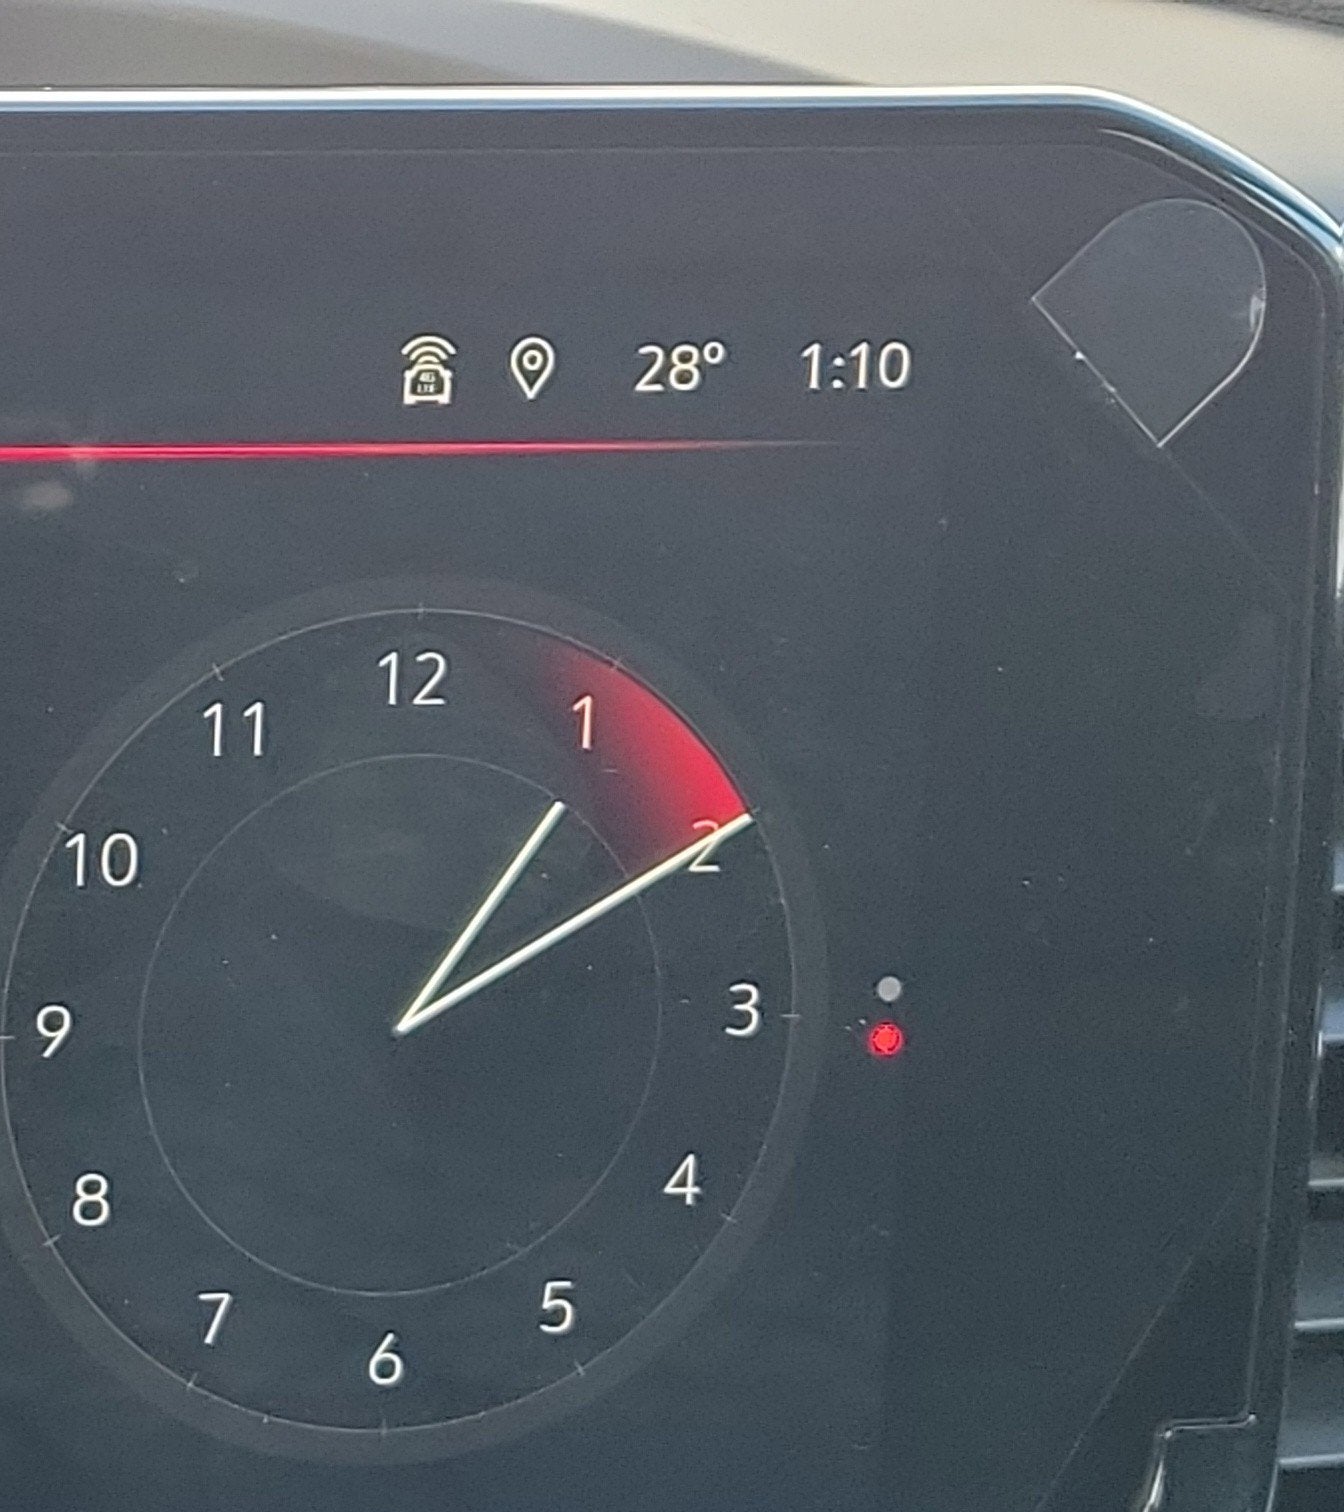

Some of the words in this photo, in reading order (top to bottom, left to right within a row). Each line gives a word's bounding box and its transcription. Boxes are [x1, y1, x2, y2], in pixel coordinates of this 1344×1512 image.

[634, 341, 725, 392] 28°
[801, 342, 910, 389] 1:10
[378, 651, 446, 705] 12
[203, 701, 263, 757] 11
[572, 695, 593, 749] 1
[65, 833, 138, 887] 10
[688, 819, 720, 873] 2
[36, 1005, 71, 1058] 9
[725, 983, 759, 1036] 3
[72, 1173, 110, 1227] 8
[663, 1153, 701, 1205] 4
[198, 1292, 231, 1344] 7
[539, 1280, 573, 1333] 5
[368, 1333, 403, 1385] 6
